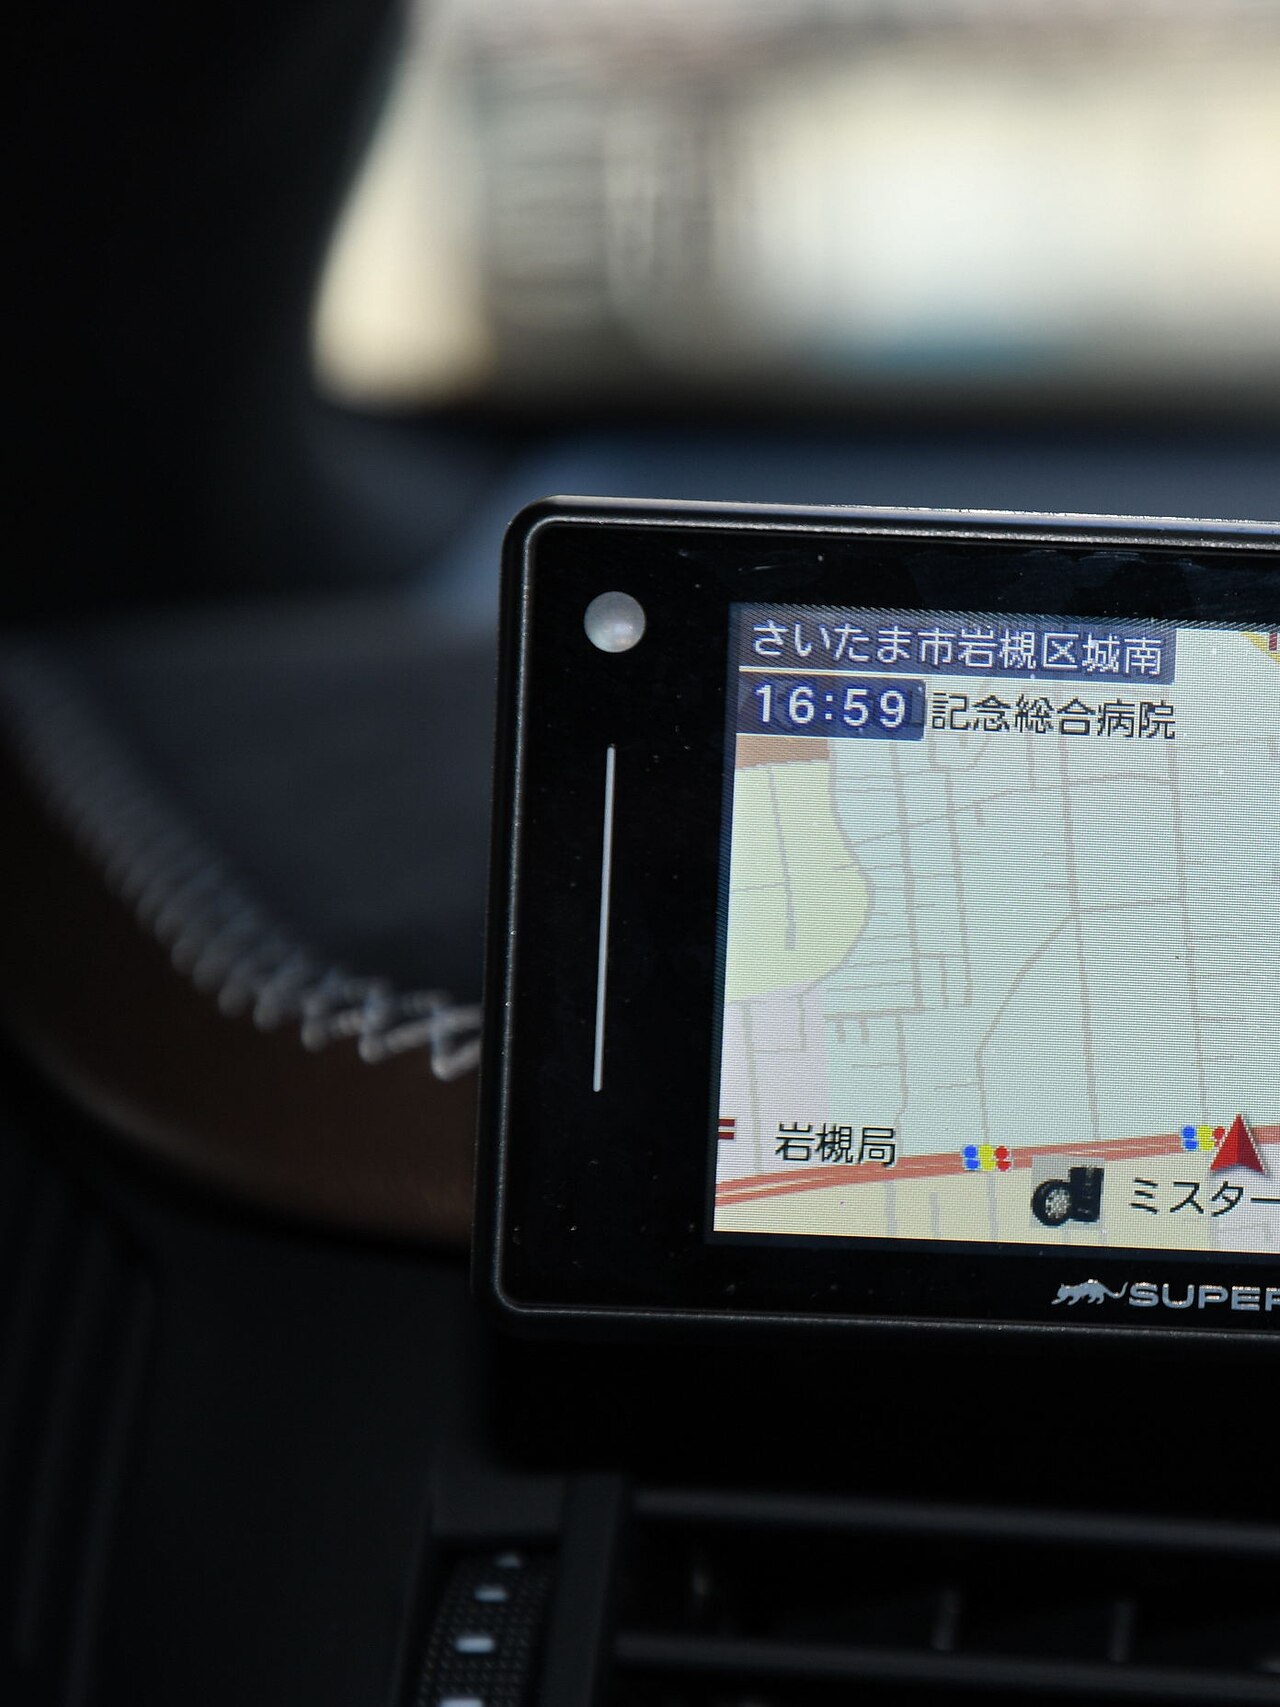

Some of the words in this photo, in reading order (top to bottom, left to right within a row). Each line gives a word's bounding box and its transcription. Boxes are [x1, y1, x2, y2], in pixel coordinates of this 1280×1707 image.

[751, 617, 1164, 676] さいたま市岩槻区城南
[754, 682, 908, 729] 16:59
[931, 691, 1176, 740] 記念総合病院
[775, 1121, 897, 1169] 岩槻局
